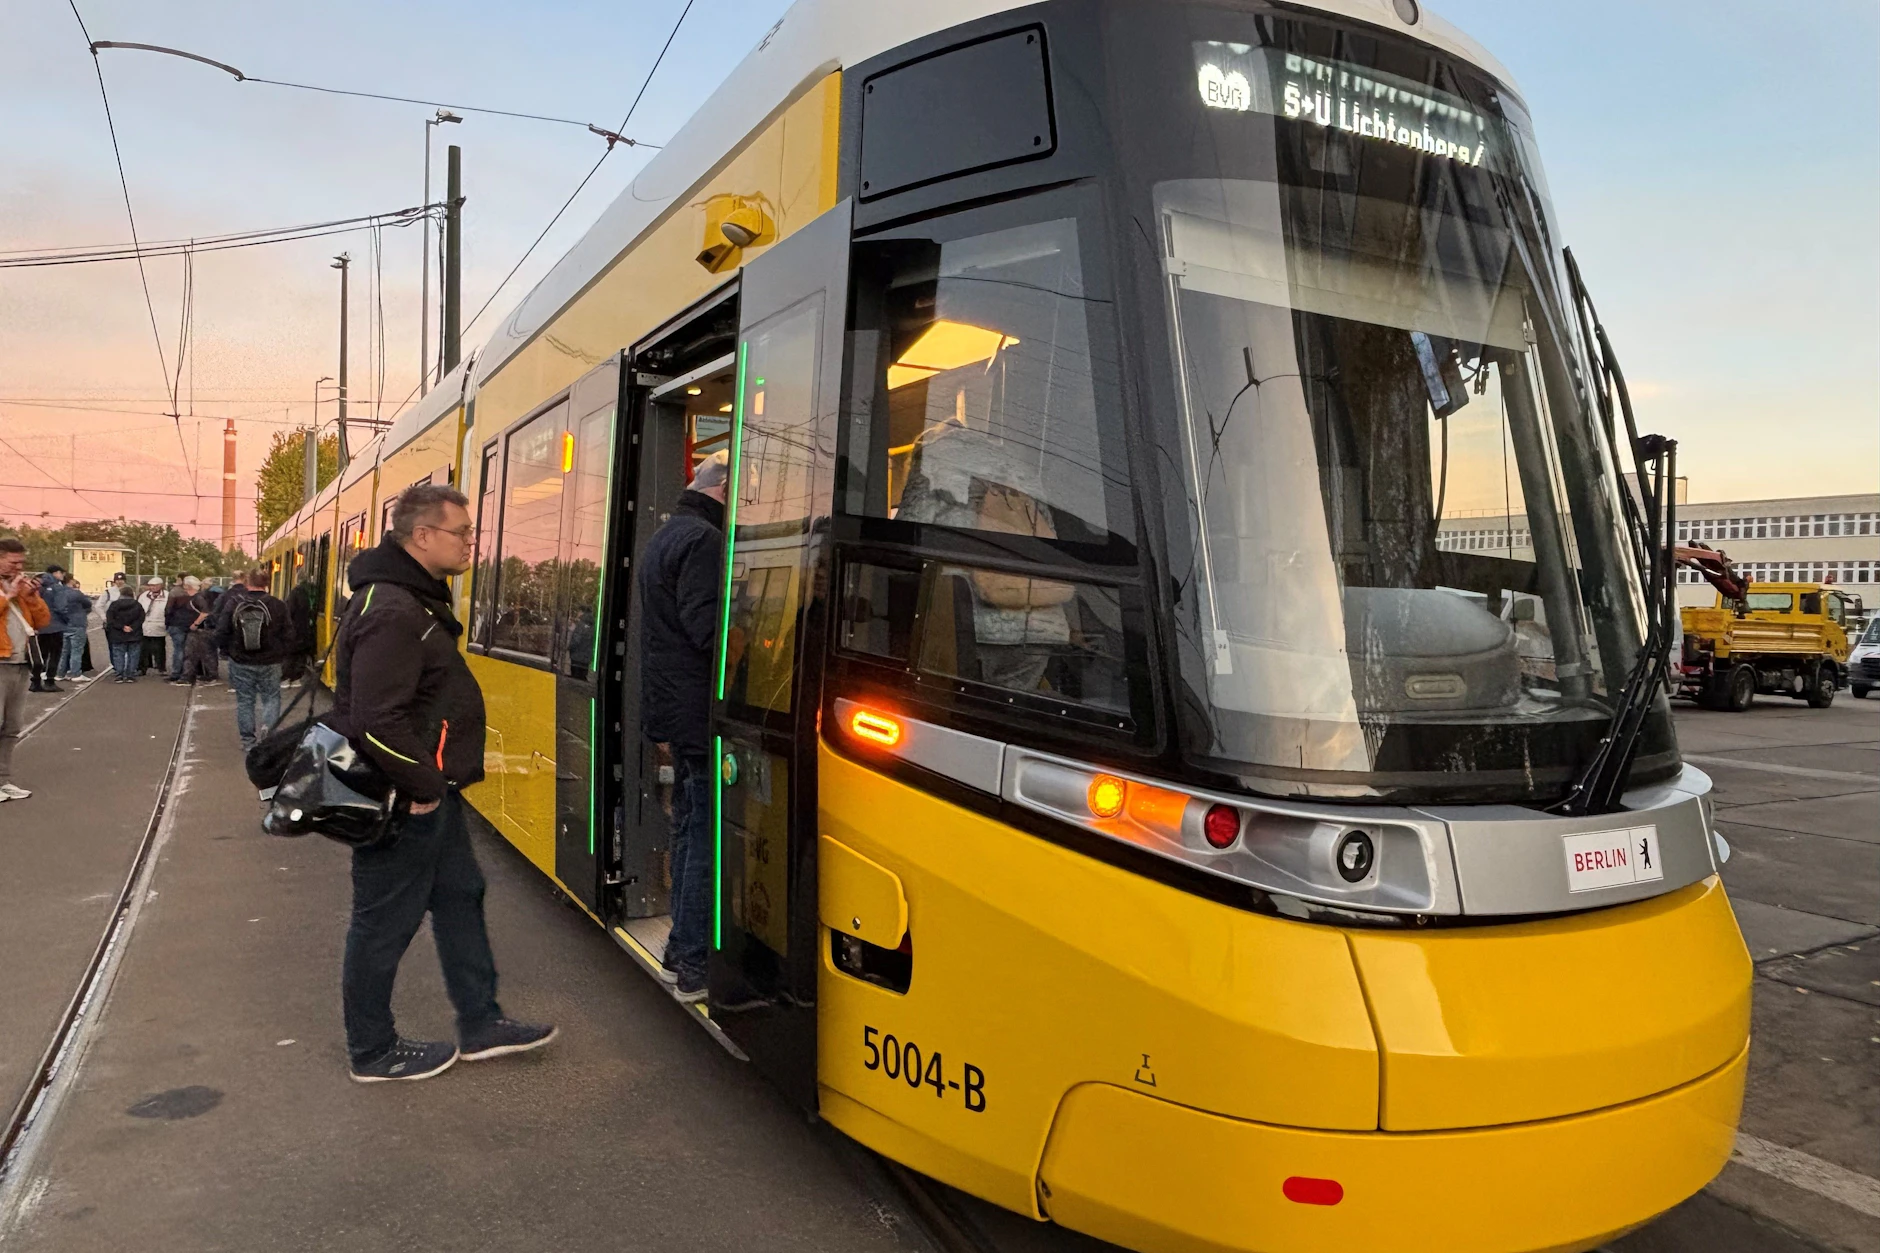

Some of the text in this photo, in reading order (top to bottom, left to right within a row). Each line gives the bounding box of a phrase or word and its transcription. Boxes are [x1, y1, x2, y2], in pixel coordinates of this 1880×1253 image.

[1284, 80, 1331, 128] S+U
[1574, 847, 1627, 872] BERLIN
[864, 1024, 986, 1113] 5004-B
